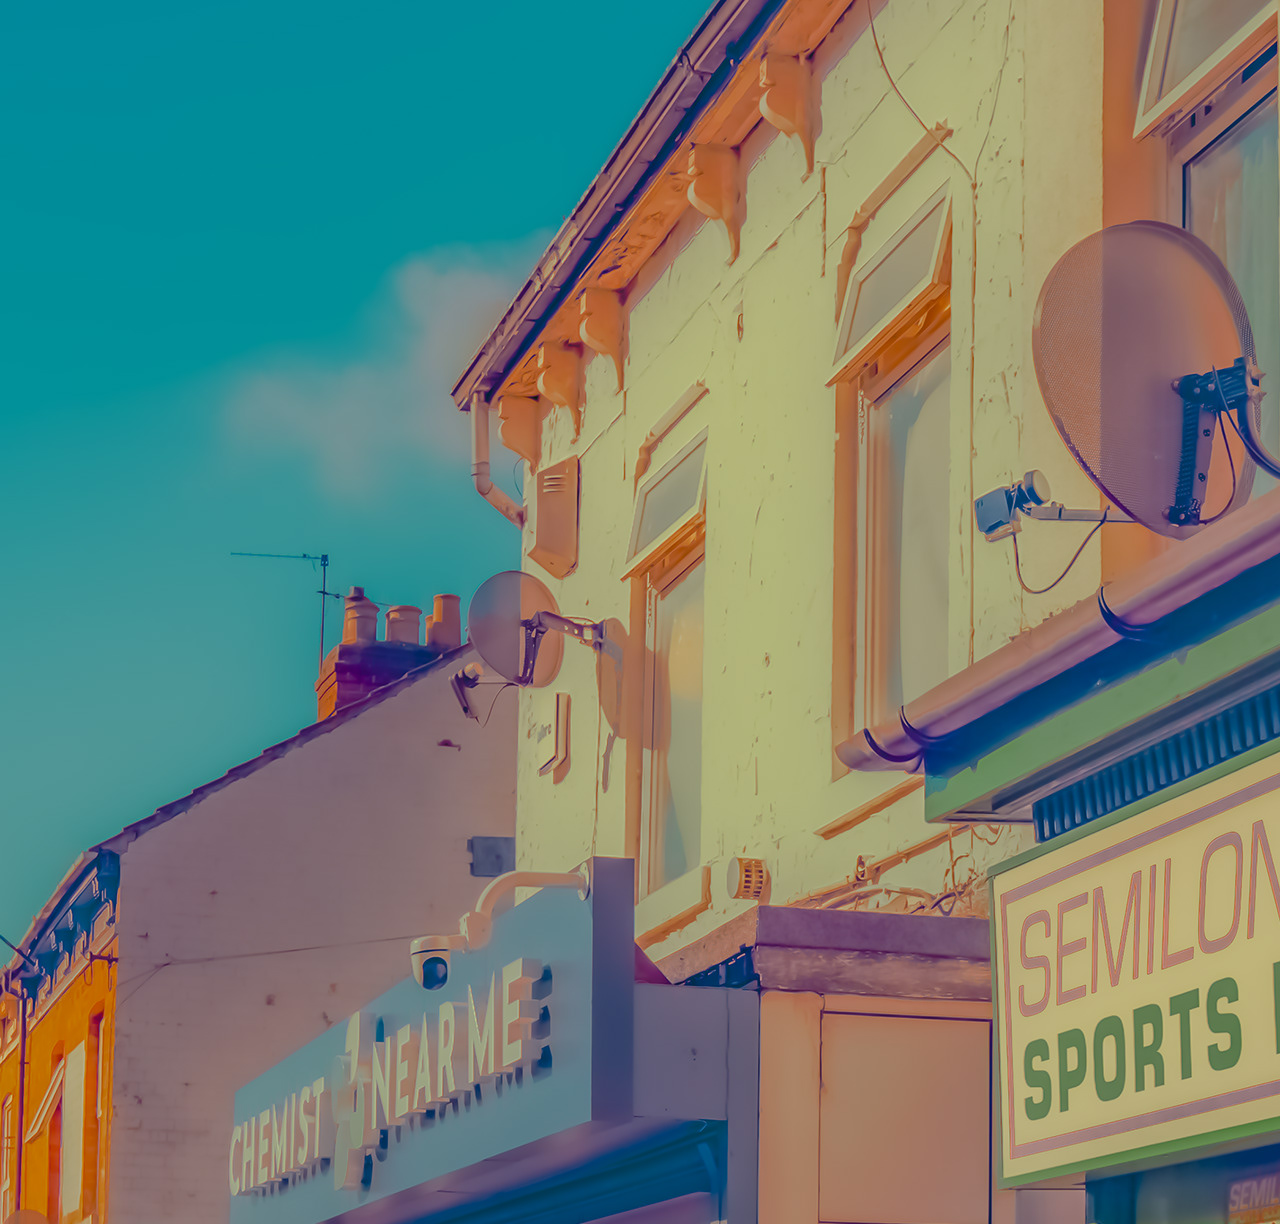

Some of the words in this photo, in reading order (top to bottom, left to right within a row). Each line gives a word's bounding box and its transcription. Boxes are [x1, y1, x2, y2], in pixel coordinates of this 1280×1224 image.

[229, 1077, 325, 1196] CHEMIST
[371, 1001, 458, 1130] NEAR
[467, 957, 532, 1084] ME
[1023, 976, 1243, 1122] SPORTS
